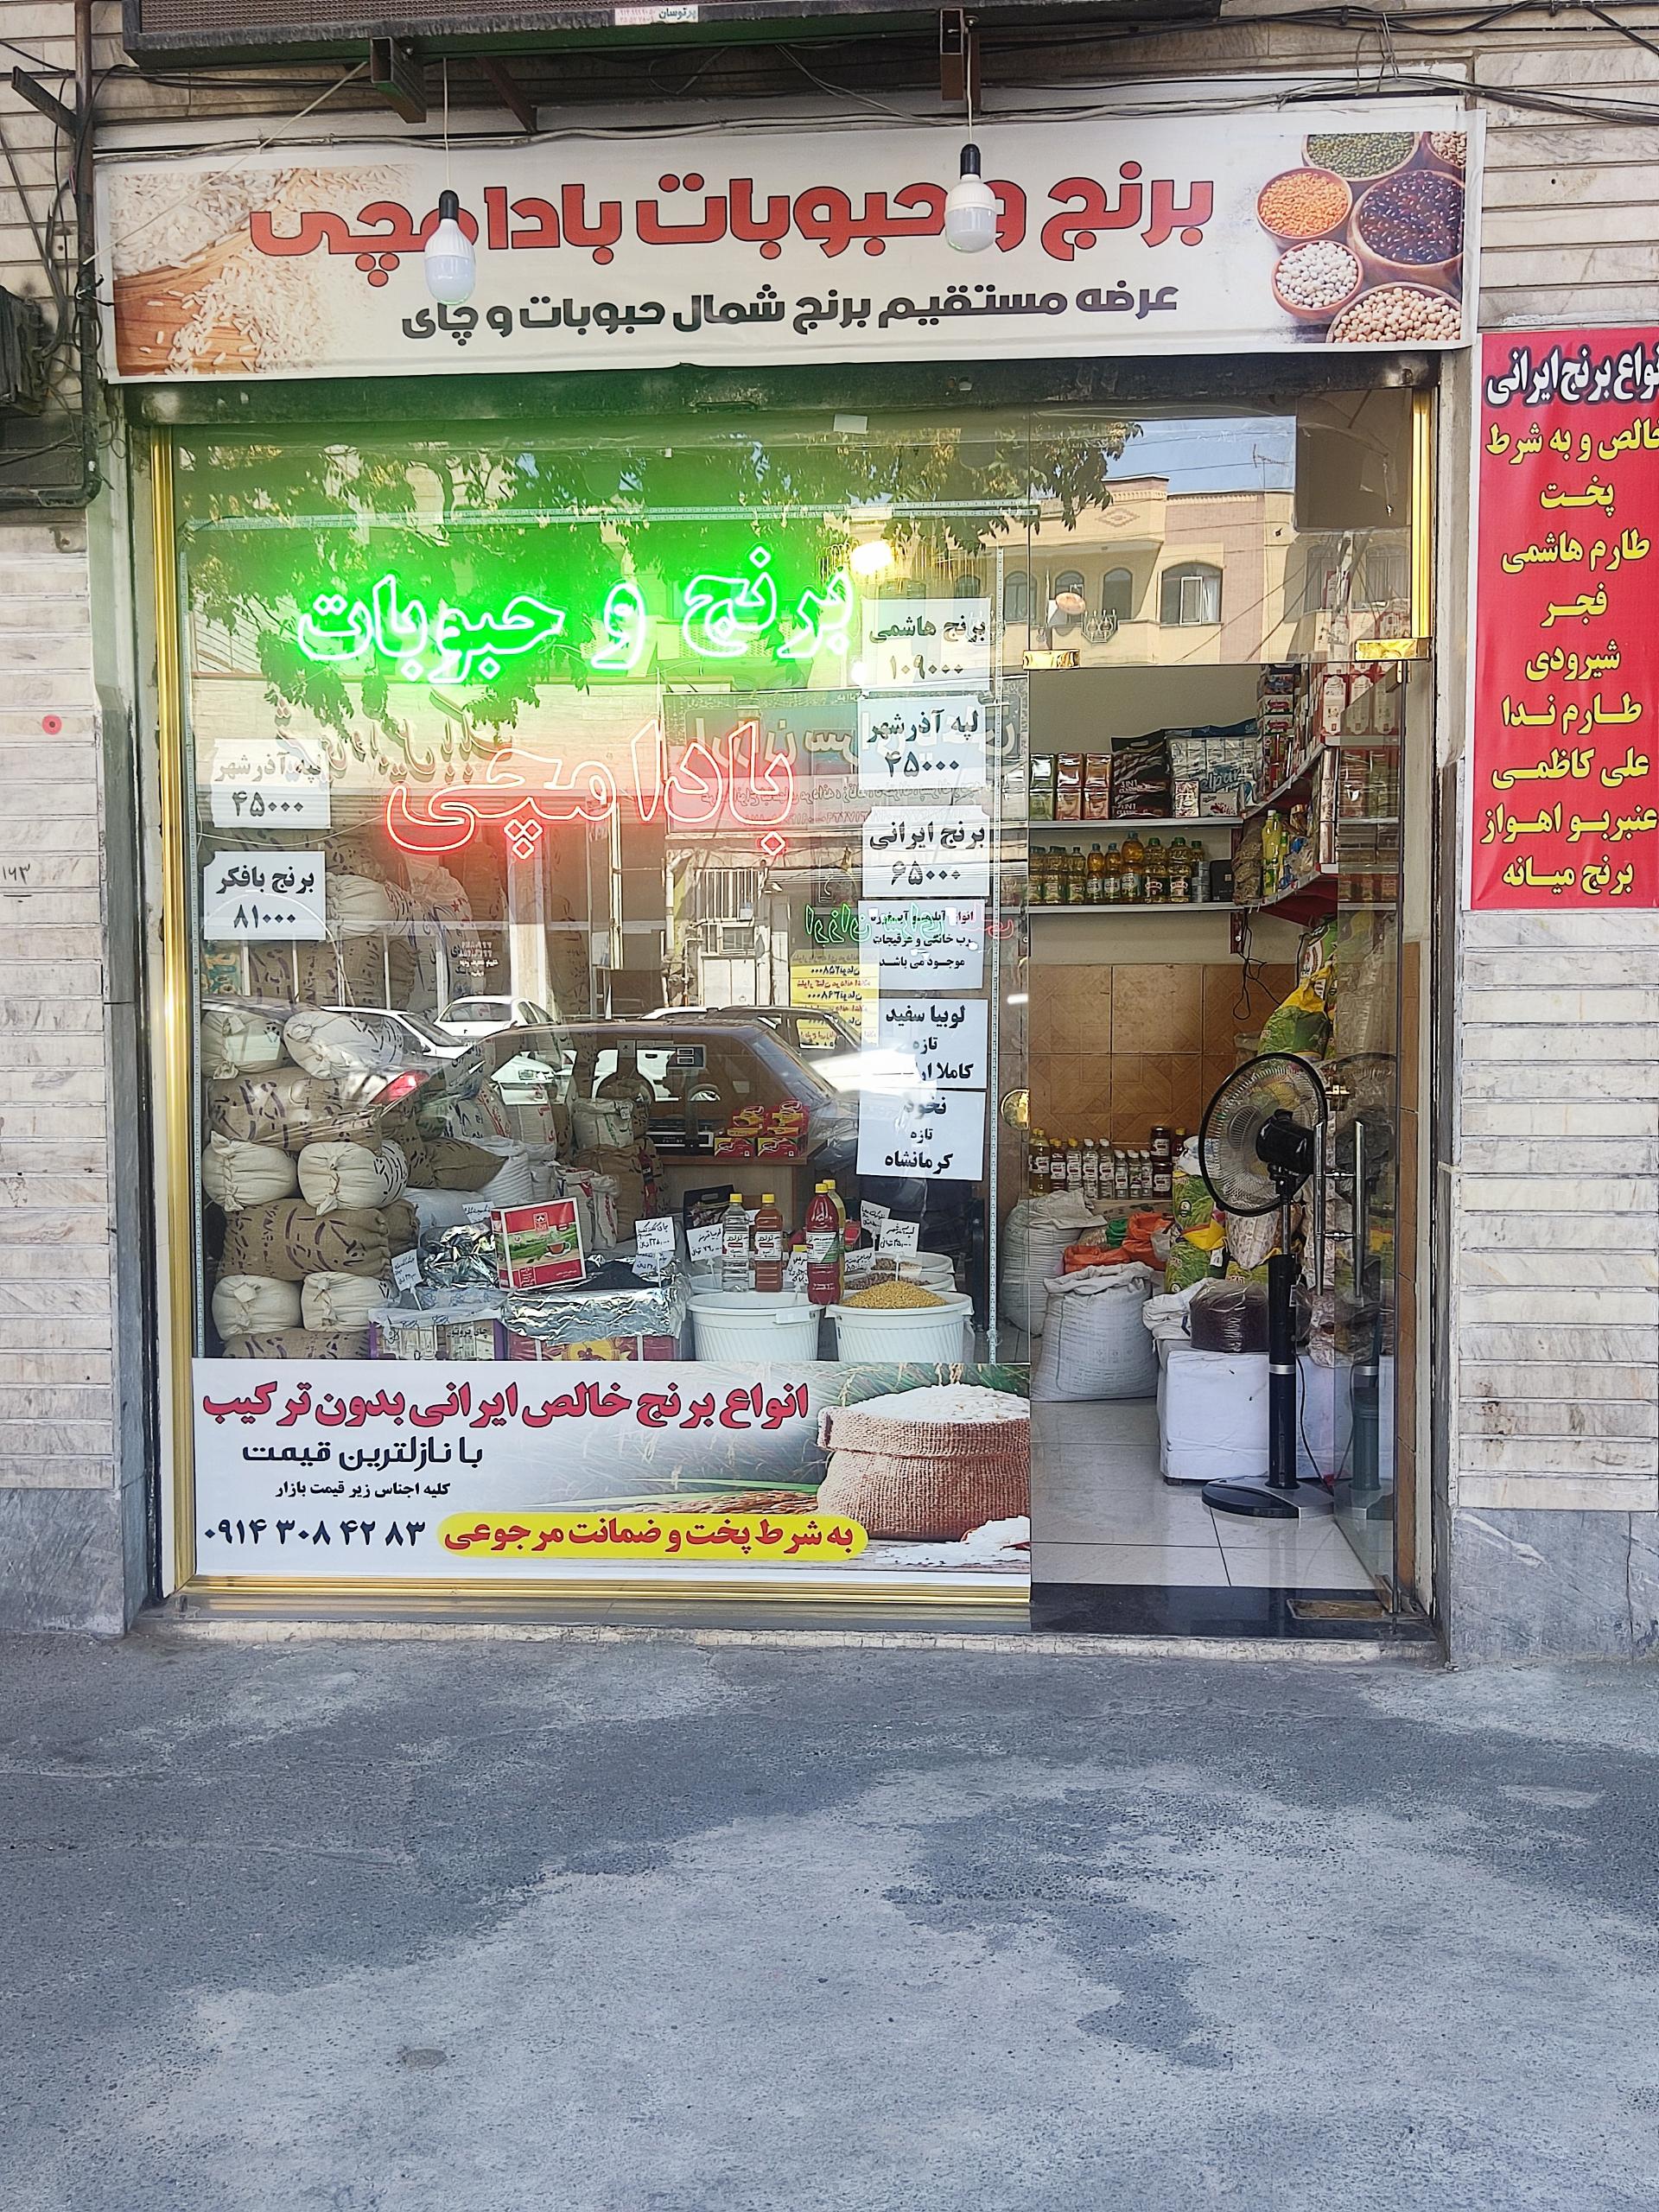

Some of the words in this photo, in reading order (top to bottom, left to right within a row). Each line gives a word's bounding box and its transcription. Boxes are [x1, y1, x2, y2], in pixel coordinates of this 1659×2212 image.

[636, 172, 949, 261] حبوبات
[983, 179, 1027, 253] و
[1039, 160, 1214, 262] برنج
[249, 182, 624, 288] بادامچی
[519, 296, 666, 336] حبوبات
[672, 283, 785, 333] شمال
[791, 287, 872, 335] برنج
[878, 283, 1066, 328] مستقیم
[1076, 279, 1179, 320] عرضه
[402, 300, 480, 346] چای
[486, 305, 512, 338] و
[1486, 346, 1559, 406] ایرانی
[1558, 344, 1613, 404] برنج
[1612, 343, 1659, 402] واع
[1485, 423, 1542, 465] شرط
[1549, 428, 1572, 461] به
[1576, 432, 1592, 461] و
[1540, 475, 1615, 517] پخت
[1501, 530, 1584, 574] هاشمی
[1589, 528, 1651, 572] طارم
[682, 544, 855, 660] برنج
[1541, 582, 1608, 626] فجر
[297, 572, 567, 685] حبوبات
[590, 580, 646, 671] و
[868, 615, 938, 644] هاشمی
[943, 614, 987, 643] برنج
[1525, 639, 1621, 681] شیرودی
[950, 709, 980, 741] لپه
[1501, 694, 1556, 728] ندا
[1561, 692, 1643, 735] طارم
[884, 750, 961, 779] ۴۵۰۰۰
[1491, 747, 1595, 790] کاظمی
[1600, 747, 1650, 788] علی
[231, 790, 304, 817] ۴۵۰۰۰
[385, 715, 797, 861] بادامچی
[869, 820, 934, 850] ایرانی
[939, 821, 985, 849] برنج
[1479, 802, 1562, 844] اهواز
[1566, 805, 1659, 843] عنبربو
[215, 864, 265, 894] بافکر
[270, 866, 315, 894] برنج
[890, 860, 962, 886] ۶۵۰۰۰
[1502, 855, 1576, 895] میانه
[1580, 854, 1634, 895] برنج
[232, 904, 296, 929] ۸۱۰۰۰
[909, 957, 925, 969] می
[885, 1006, 925, 1023] سفید
[930, 1005, 966, 1029] لوبیا
[912, 1036, 938, 1054] تازه
[936, 1062, 975, 1079] کاملا
[910, 1128, 934, 1143] تازه
[884, 1149, 954, 1175] کرمانشاه
[202, 1381, 312, 1427] ترکیب
[314, 1389, 406, 1427] بدون
[409, 1382, 519, 1428] ایرانی
[522, 1381, 632, 1427] خالص
[636, 1382, 715, 1428] برنج
[718, 1382, 809, 1429] انواع
[242, 1440, 331, 1468] قیمت
[338, 1435, 453, 1471] نازلترین
[458, 1436, 484, 1469] با
[274, 1480, 307, 1498] بازار
[309, 1480, 346, 1497] قیمت
[347, 1481, 371, 1499] زیر
[373, 1481, 421, 1498] اجناس
[423, 1481, 451, 1497] کلیه
[204, 1518, 268, 1545] ۰۹۱۴
[276, 1518, 331, 1546] ۳۰۸
[340, 1519, 377, 1546] ۴۲
[385, 1520, 426, 1547] ۸۳
[443, 1523, 566, 1552] مرجوعی
[568, 1516, 661, 1544] ضمانت
[664, 1528, 681, 1553] و
[685, 1518, 752, 1554] پخت
[755, 1519, 823, 1554] شرط
[826, 1526, 854, 1553] به
